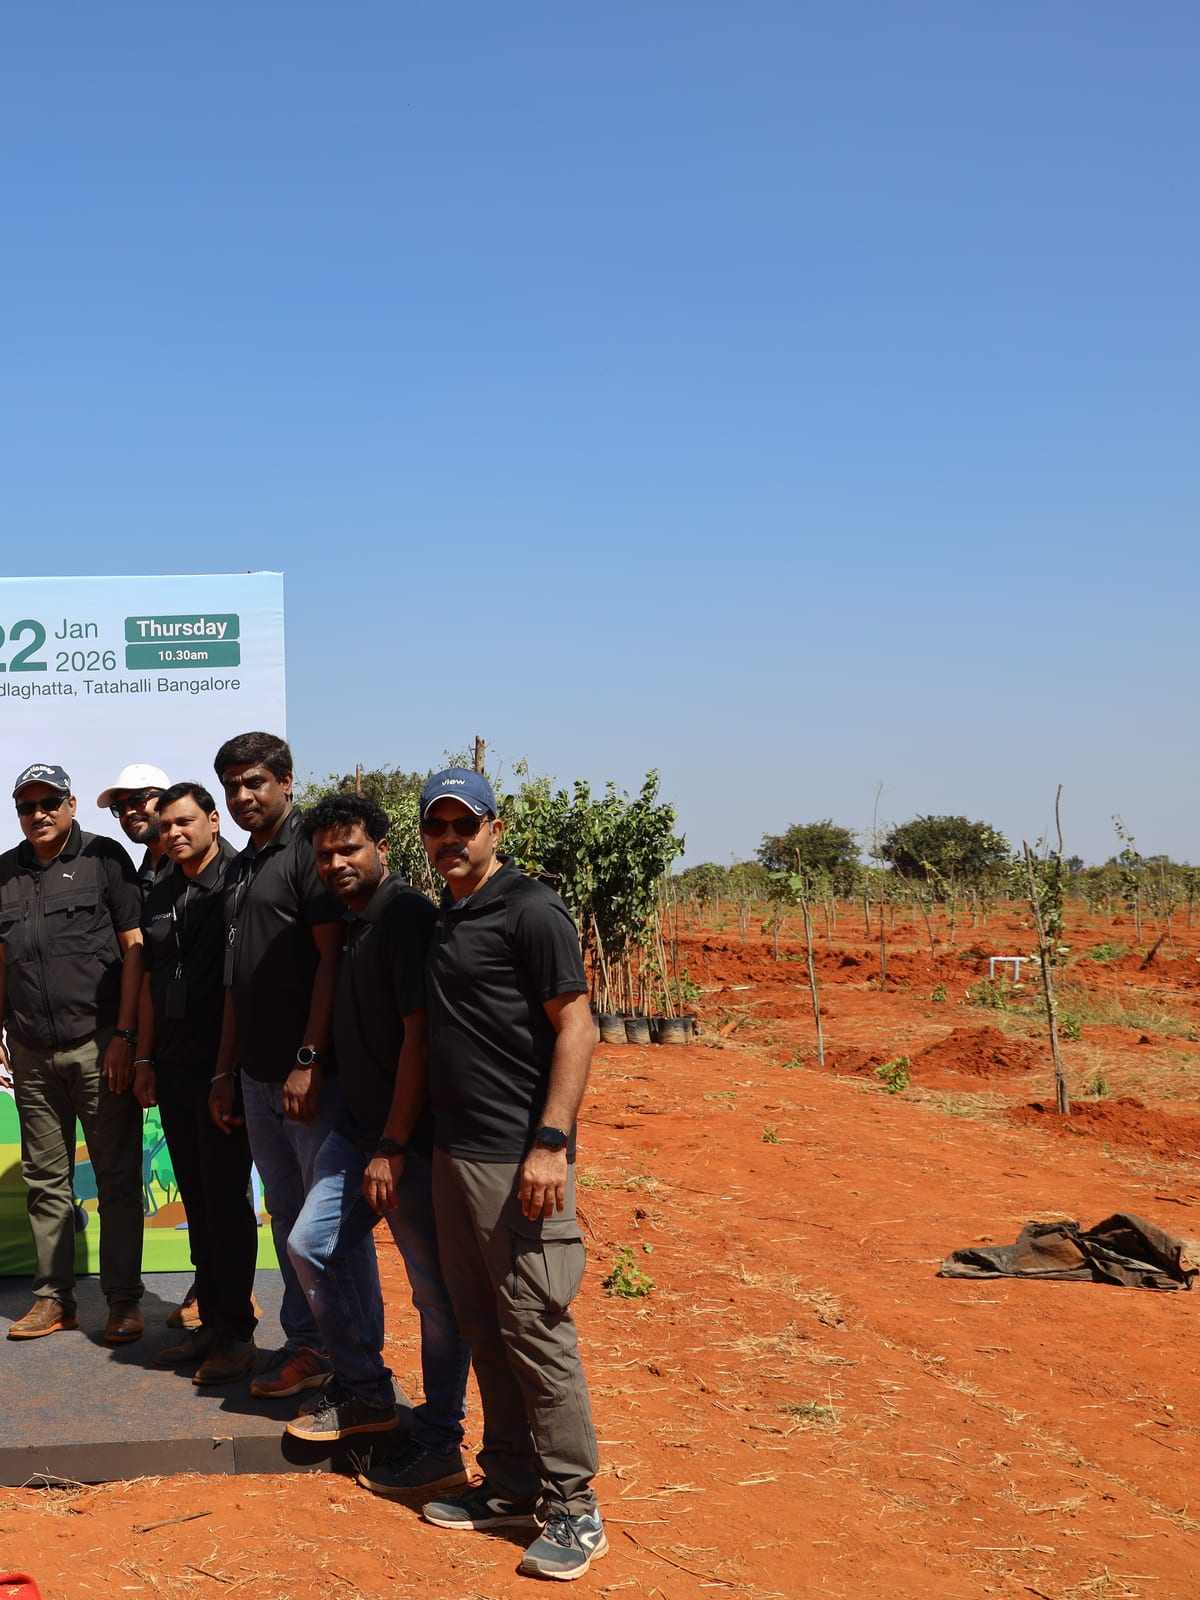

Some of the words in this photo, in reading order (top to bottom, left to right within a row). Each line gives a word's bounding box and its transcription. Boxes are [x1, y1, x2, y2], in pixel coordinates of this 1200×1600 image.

[54, 618, 98, 639] Jan
[136, 618, 228, 639] Thursday
[56, 650, 116, 672] 2026
[158, 650, 209, 661] 10.30am
[83, 679, 151, 694] Tatahalli
[157, 677, 241, 694] Bangalore
